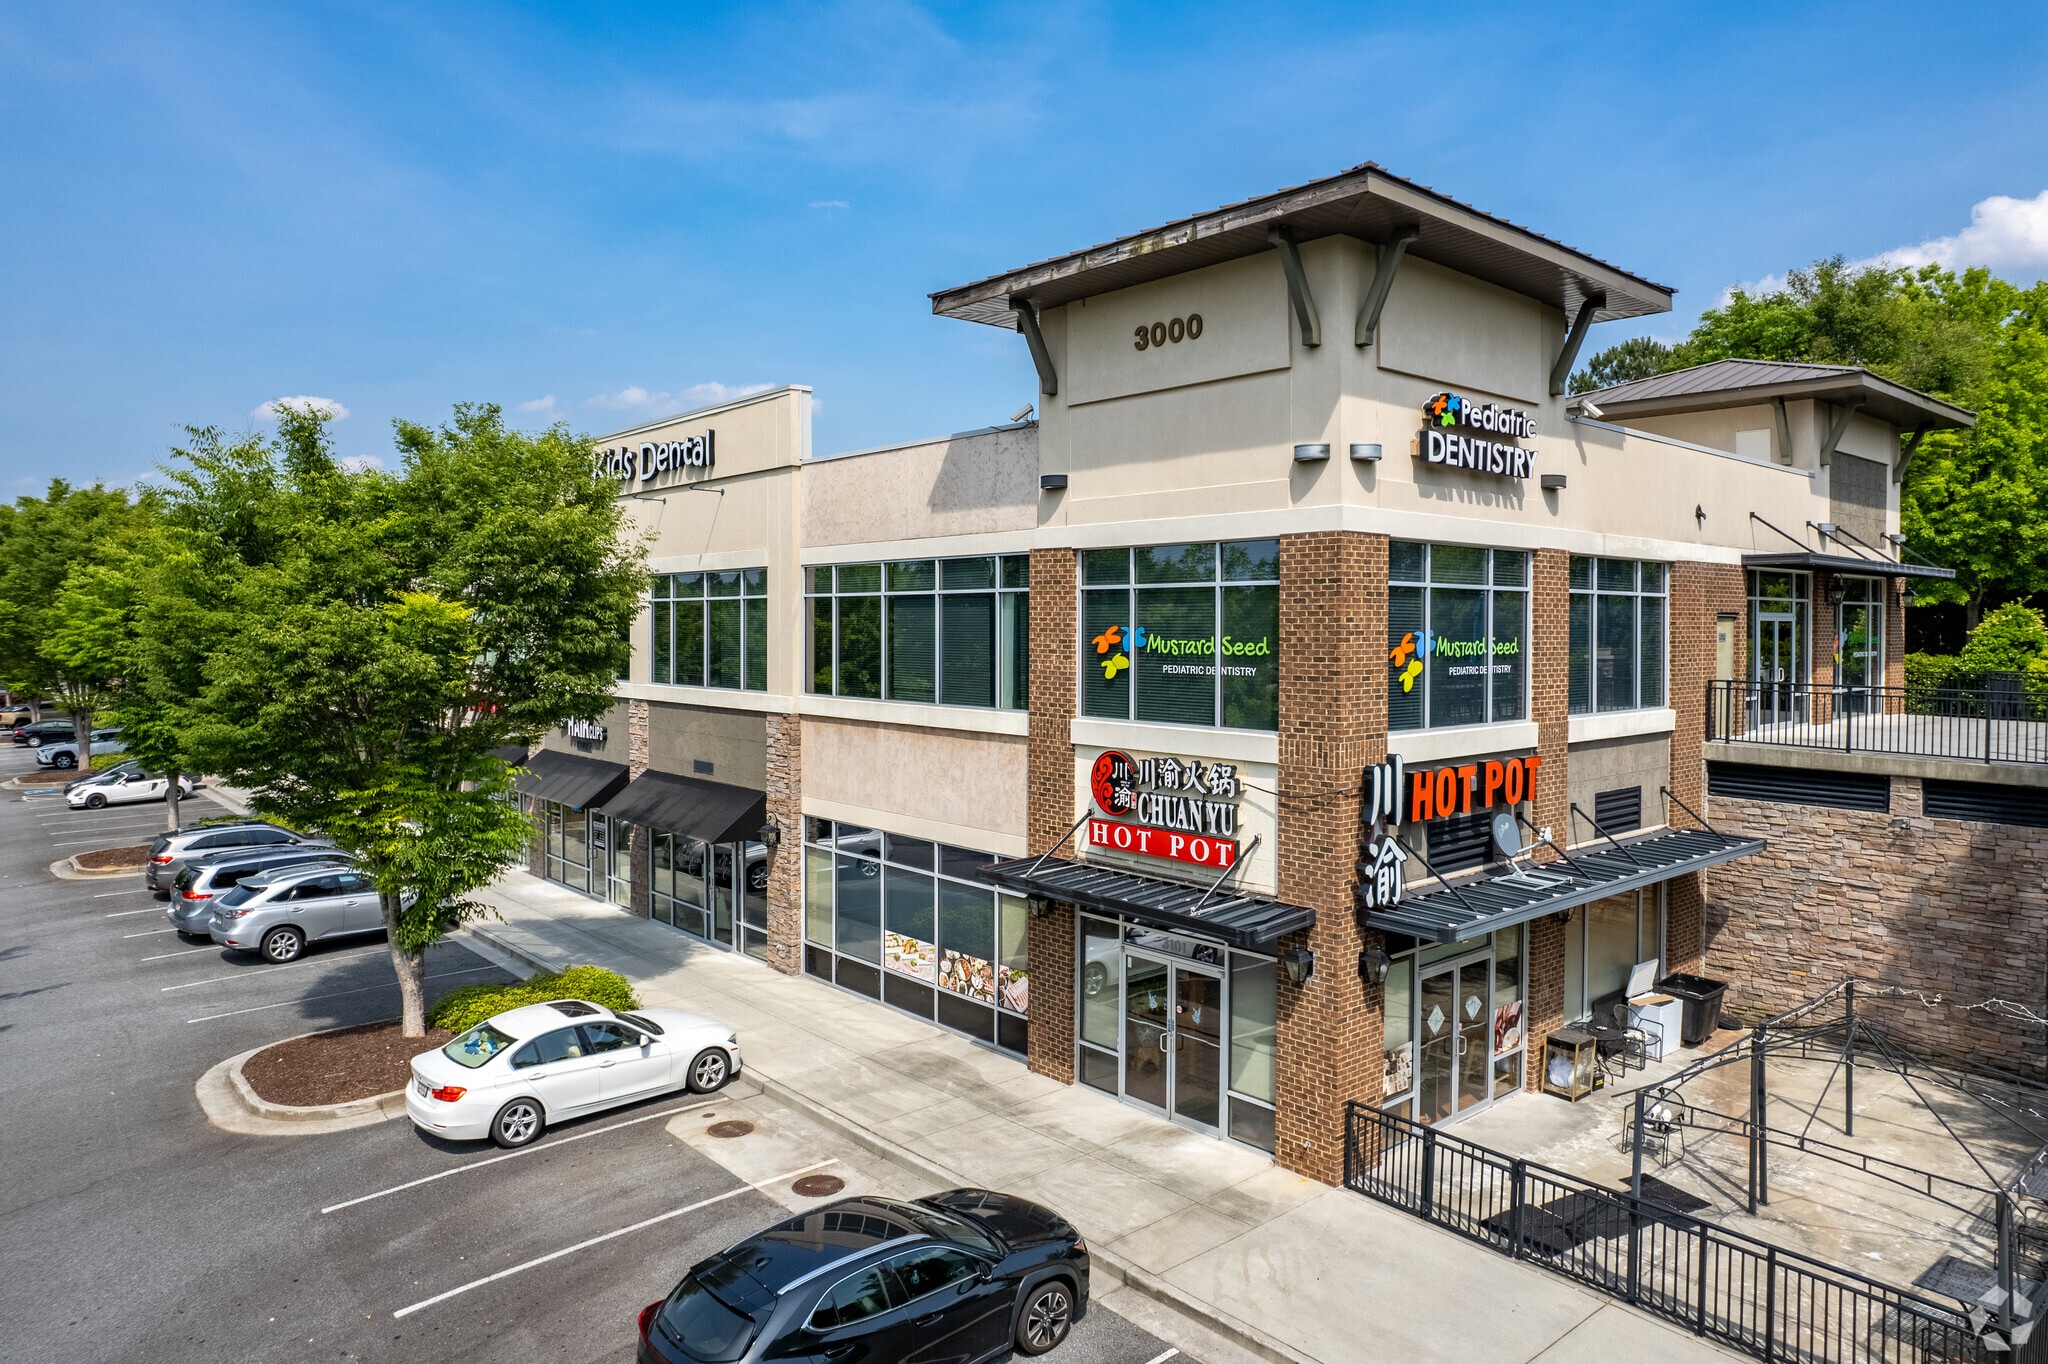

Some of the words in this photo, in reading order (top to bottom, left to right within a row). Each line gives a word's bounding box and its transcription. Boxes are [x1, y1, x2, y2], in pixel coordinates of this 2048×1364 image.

[1134, 313, 1203, 351] 3000
[1461, 397, 1537, 439] Pediatric
[592, 446, 634, 482] Kids
[640, 429, 713, 481] Dental
[1427, 430, 1539, 479] DENTISTRY
[1147, 633, 1215, 656] Mustard
[1221, 636, 1270, 656] Seed
[1436, 635, 1487, 657] Mustard
[1163, 664, 1204, 675] PEDIATRIC
[1205, 665, 1257, 677] DENTISTRY
[1449, 665, 1479, 676] PEDIATRIC
[1479, 665, 1512, 675] DETISTRY
[1138, 758, 1237, 799] 川渝火锅
[1412, 764, 1477, 823] HOT
[1485, 756, 1542, 808] POT
[1091, 821, 1152, 853] HOT
[1169, 834, 1232, 867] POT
[1364, 753, 1408, 908] 川渝
